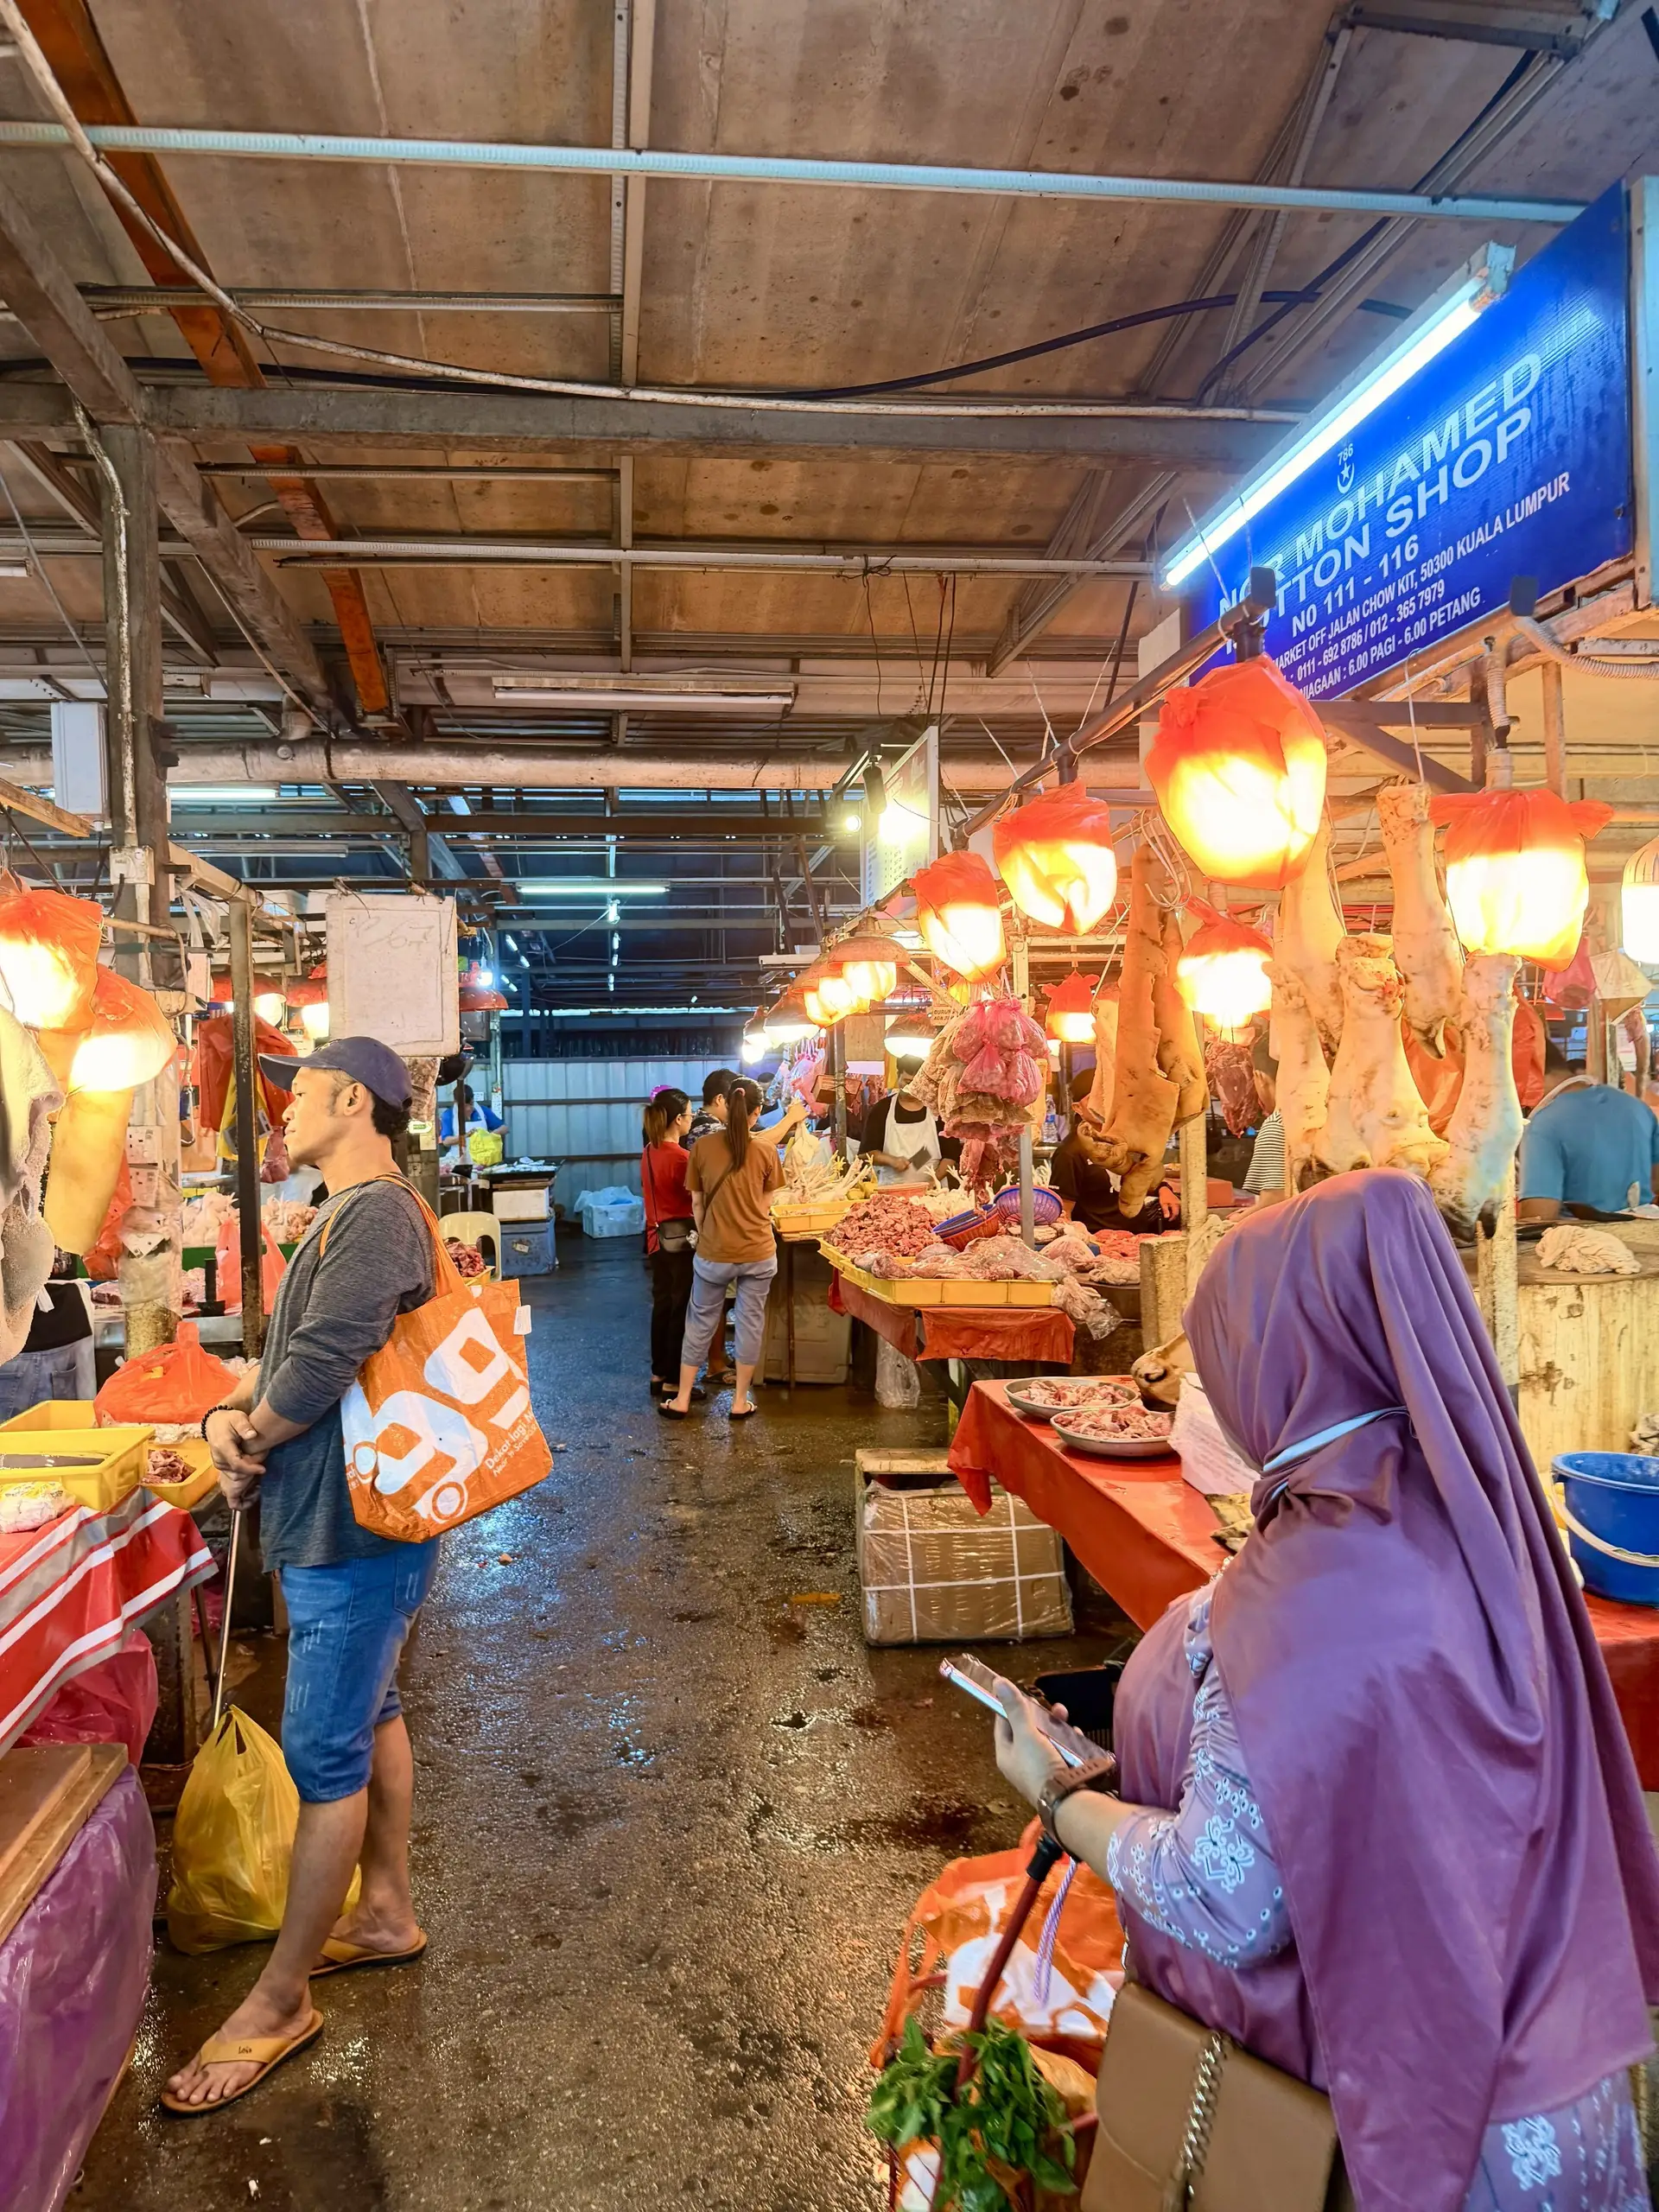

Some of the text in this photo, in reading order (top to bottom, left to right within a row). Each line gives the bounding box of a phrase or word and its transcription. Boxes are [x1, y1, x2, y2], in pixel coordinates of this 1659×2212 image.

[1219, 353, 1541, 617] NR MOHAMED
[1337, 443, 1354, 465] 786
[1385, 408, 1531, 537] SHOP
[1292, 604, 1317, 638] NO
[1324, 577, 1354, 614] 111
[1379, 534, 1419, 577] 116
[1308, 626, 1326, 651] OFF
[1328, 606, 1360, 639] JALAN
[1363, 582, 1395, 617] CHOW
[1398, 569, 1418, 596] KIT,
[1421, 546, 1454, 582] 50300
[1457, 515, 1503, 560] KUALA
[1506, 472, 1570, 529] LUMPUR
[1297, 657, 1315, 681] 0111
[1323, 643, 1338, 665] 692
[1340, 628, 1363, 655] 8786
[1370, 613, 1388, 639] 012
[1396, 596, 1415, 622] 365
[1417, 579, 1445, 610] 7979
[1348, 652, 1368, 677] 6.00
[1370, 635, 1395, 664] PAGI
[1404, 618, 1427, 645] 6.00
[1429, 587, 1480, 631] PETANG
[484, 1439, 512, 1470] Dekat
[507, 1419, 527, 1441] lagi
